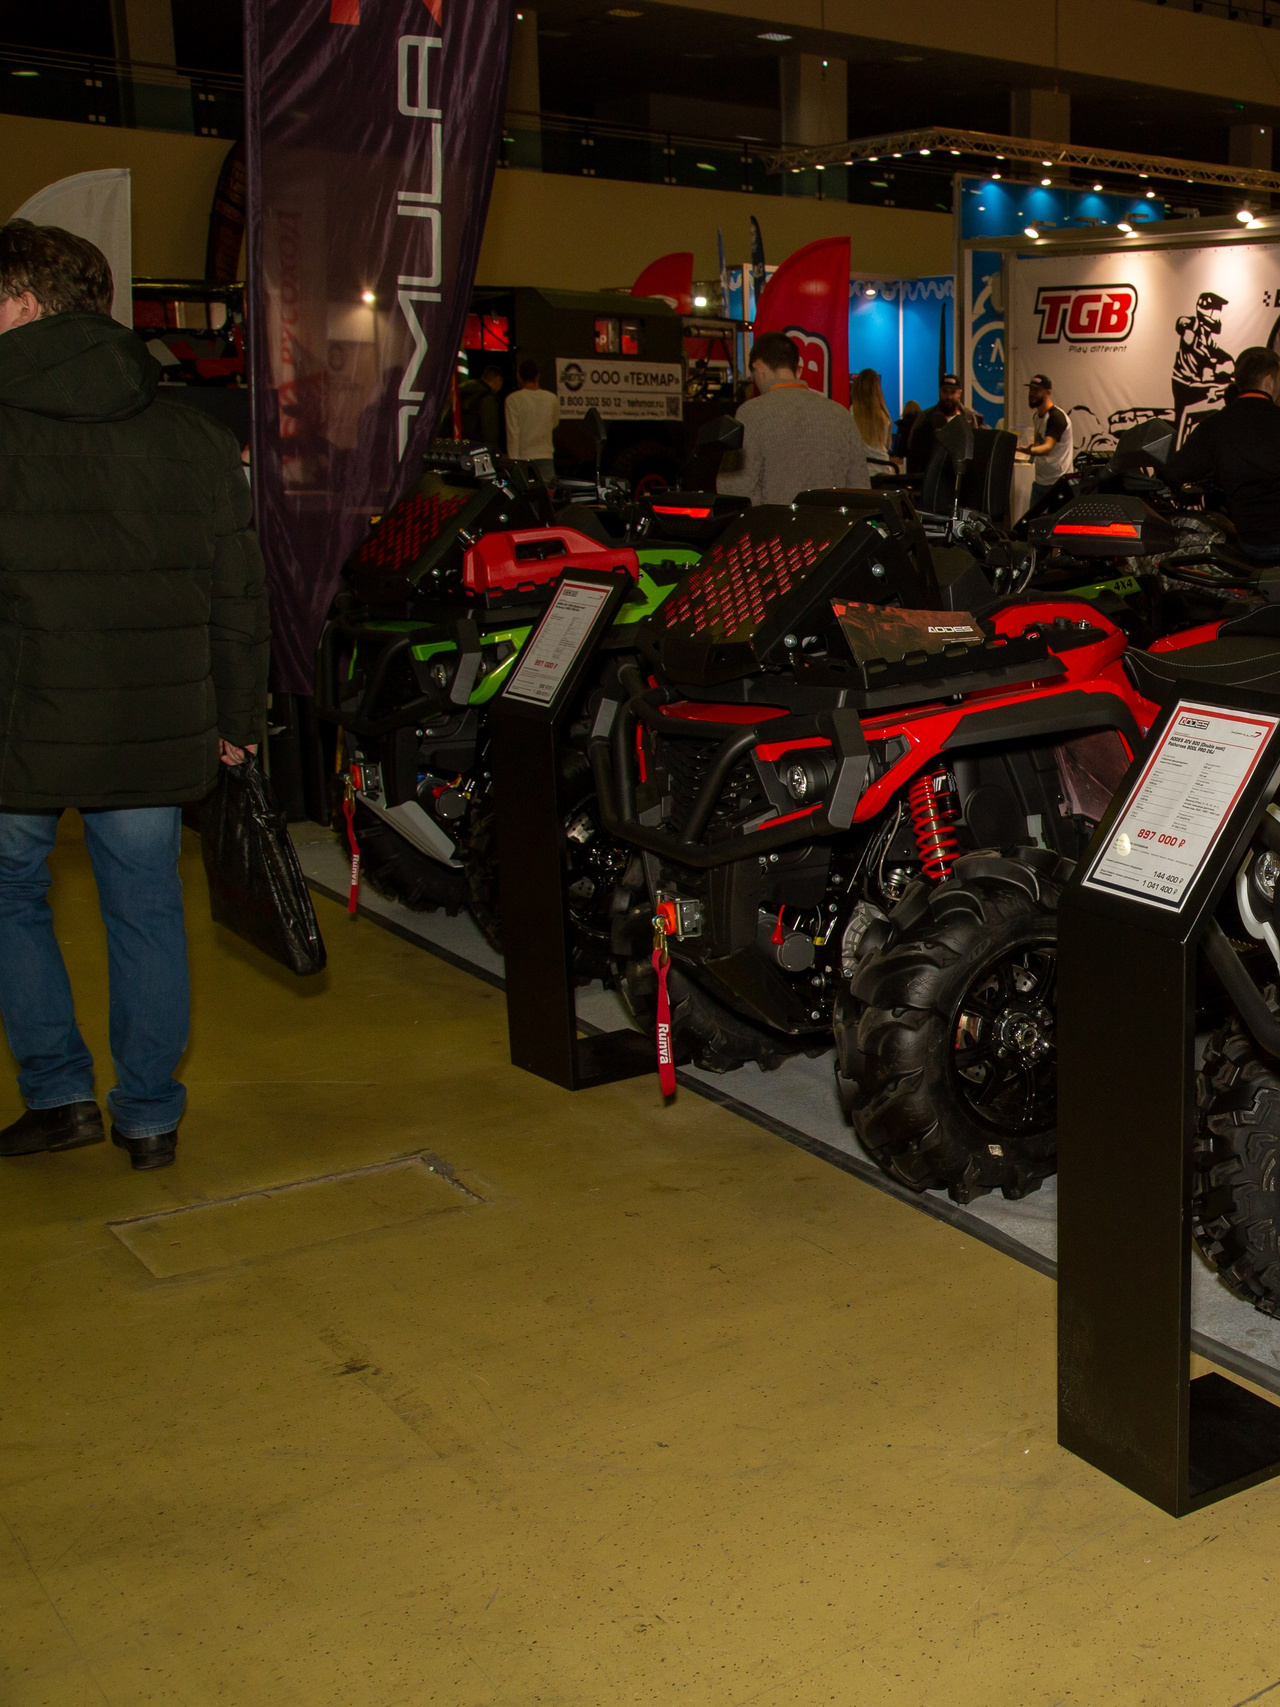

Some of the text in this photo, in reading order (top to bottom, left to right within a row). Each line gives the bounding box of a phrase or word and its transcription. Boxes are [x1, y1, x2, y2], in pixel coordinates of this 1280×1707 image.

[1038, 287, 1135, 340] TGB
[1090, 344, 1127, 353] different
[591, 370, 620, 384] ООО
[928, 625, 973, 634] AODES
[1137, 829, 1156, 841] 897
[1158, 833, 1178, 846] 000
[1154, 870, 1166, 880] 144
[1166, 874, 1179, 884] 400
[658, 1023, 669, 1064] Runva
